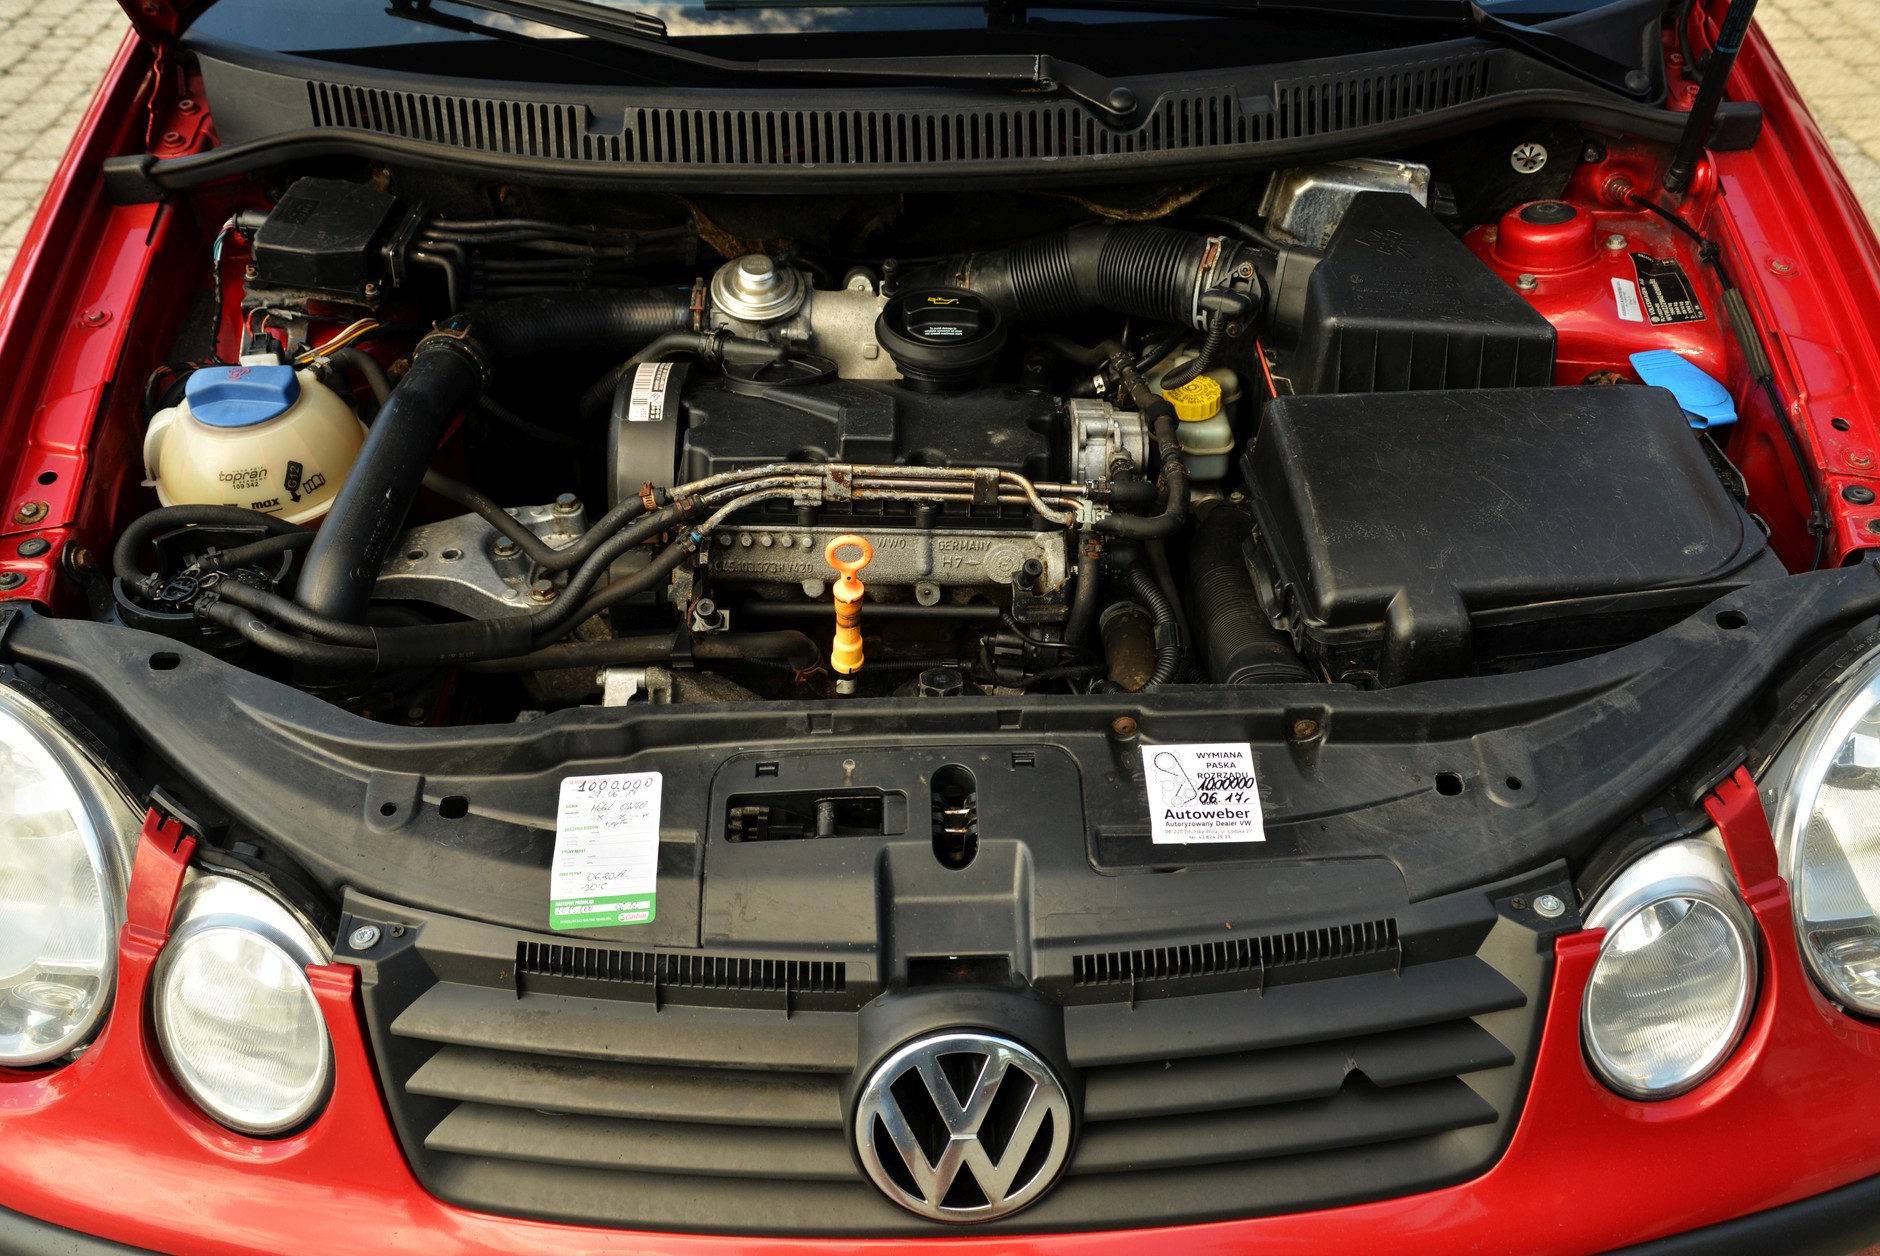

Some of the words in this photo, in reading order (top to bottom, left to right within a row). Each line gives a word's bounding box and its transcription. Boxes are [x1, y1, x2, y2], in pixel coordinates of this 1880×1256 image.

[218, 468, 268, 484] topran
[288, 465, 300, 488] G12
[251, 498, 280, 510] max
[937, 539, 991, 551] GERMANY
[941, 555, 963, 568] H7
[1164, 808, 1250, 820] Autoweber
[624, 912, 647, 920] Castrol
[862, 1040, 1062, 1214] VW
